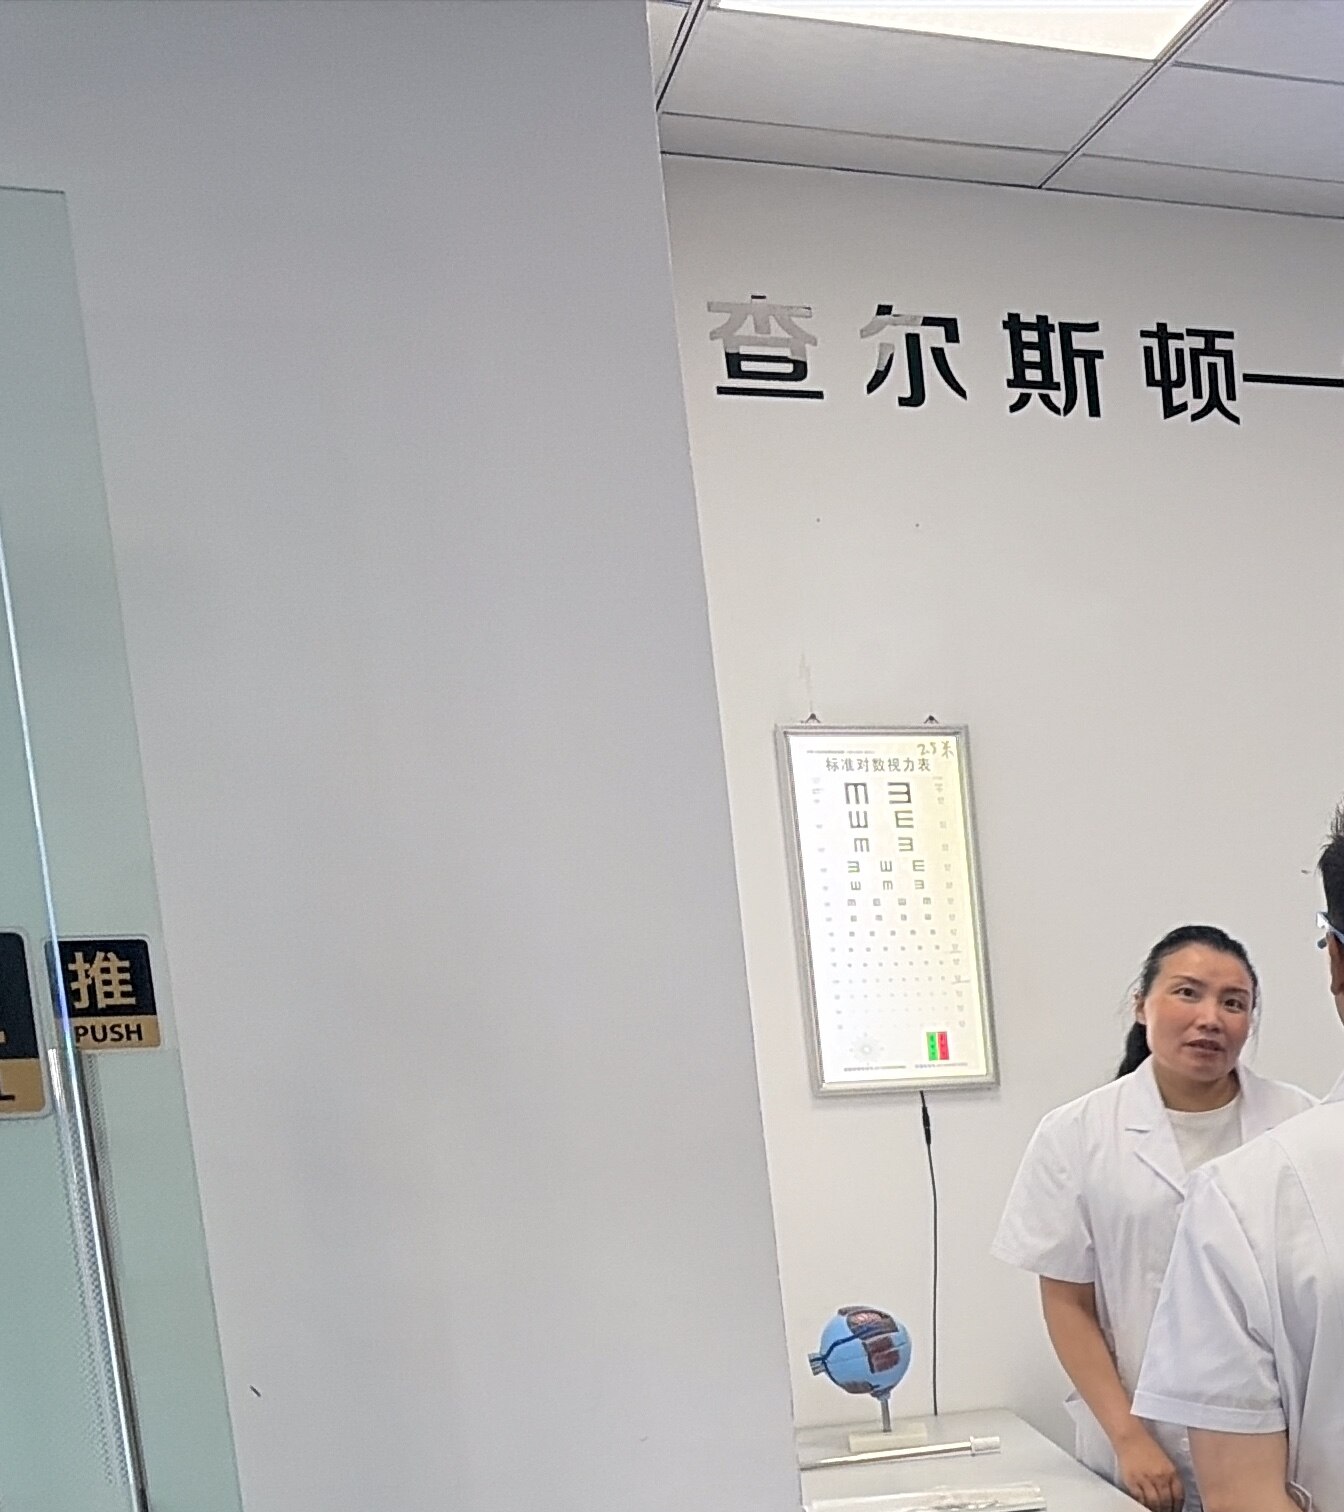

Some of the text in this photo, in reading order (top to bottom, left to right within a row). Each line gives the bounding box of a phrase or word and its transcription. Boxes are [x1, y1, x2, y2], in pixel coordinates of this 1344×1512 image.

[825, 757, 932, 773] 标准对数视力表
[67, 950, 137, 1009] 推
[75, 1023, 144, 1043] PUSH
